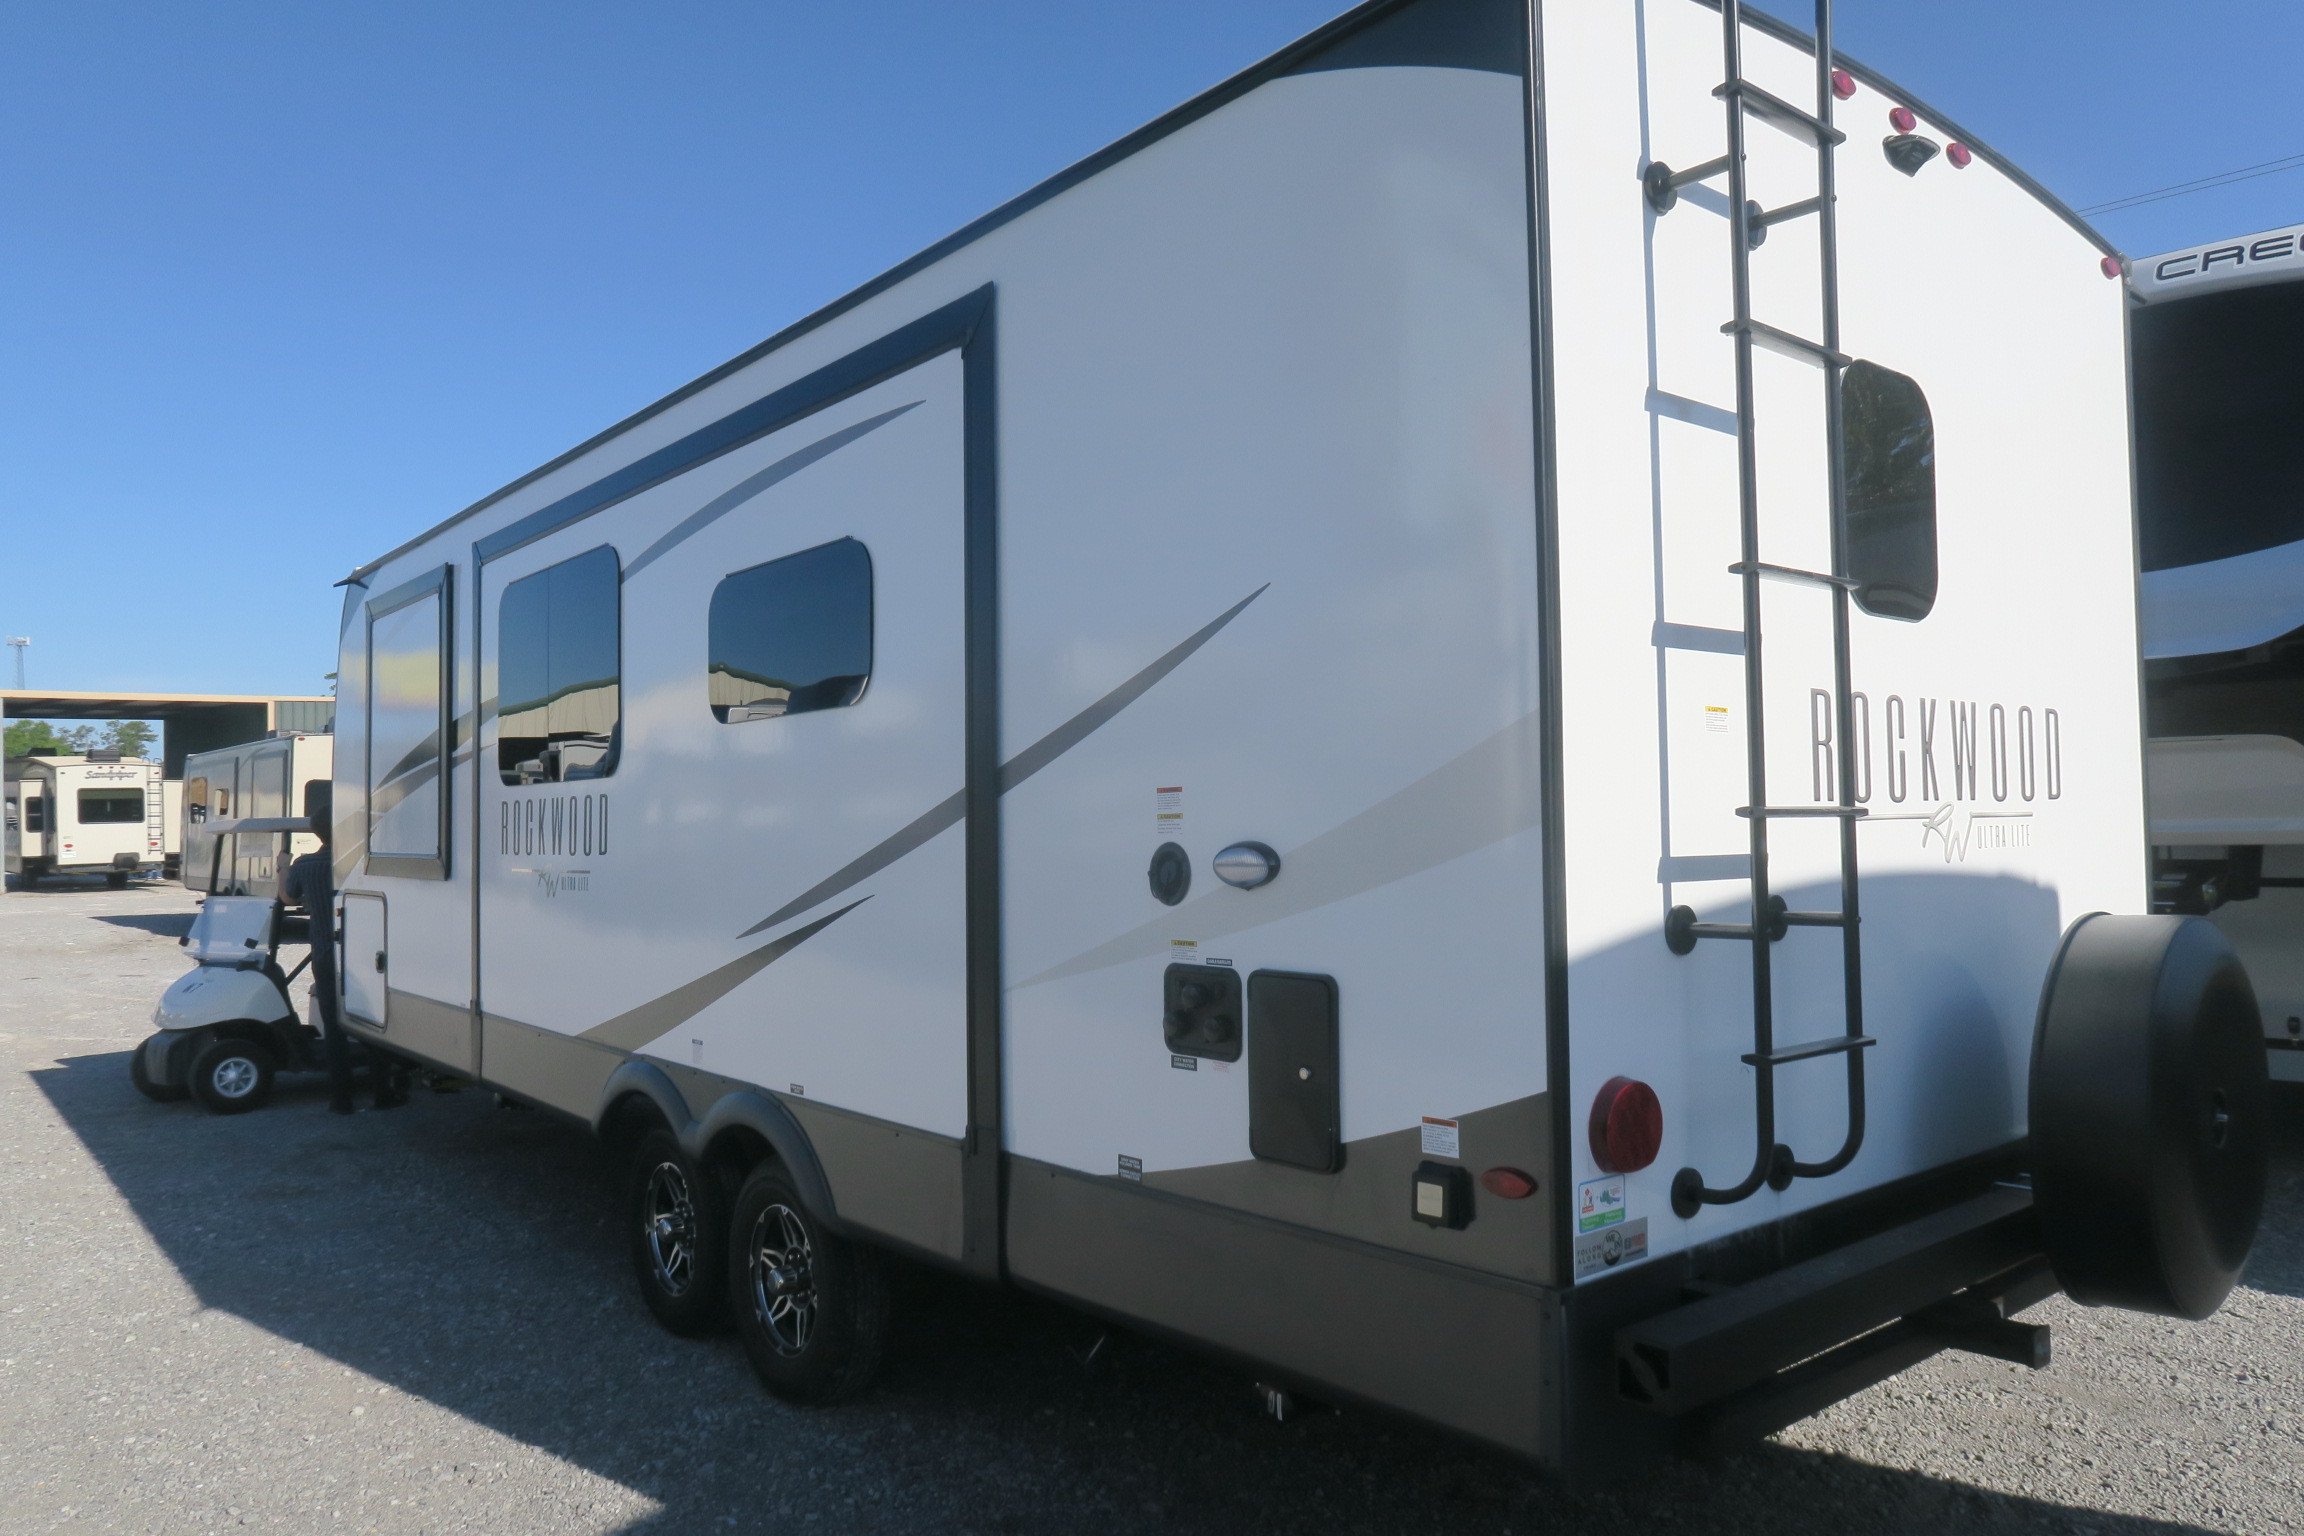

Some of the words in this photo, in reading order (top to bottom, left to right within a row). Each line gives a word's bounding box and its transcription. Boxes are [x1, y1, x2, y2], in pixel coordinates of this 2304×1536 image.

[2155, 232, 2304, 281] CRE
[1810, 687, 2061, 804] ROCKWOOD
[501, 793, 609, 857] ROCKWOOD
[1976, 823, 2007, 850] ULTRA
[2010, 823, 2031, 847] LITE
[561, 876, 576, 891] ULTRA
[577, 876, 590, 892] LITE
